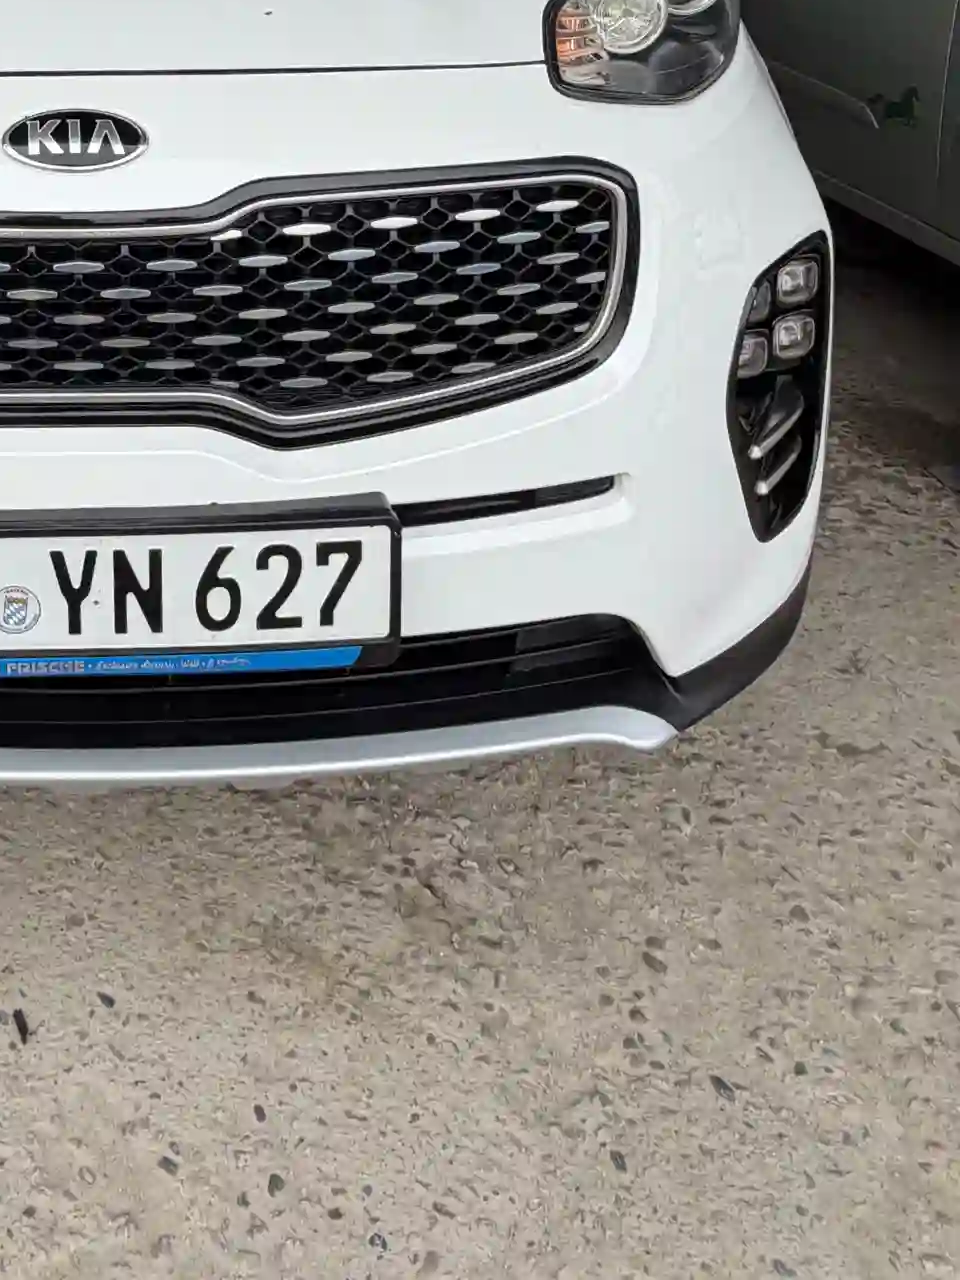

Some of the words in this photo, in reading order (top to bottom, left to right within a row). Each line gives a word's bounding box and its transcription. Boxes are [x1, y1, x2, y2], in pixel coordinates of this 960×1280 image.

[26, 119, 125, 155] KIA
[50, 548, 163, 635] YN
[195, 540, 364, 632] 627
